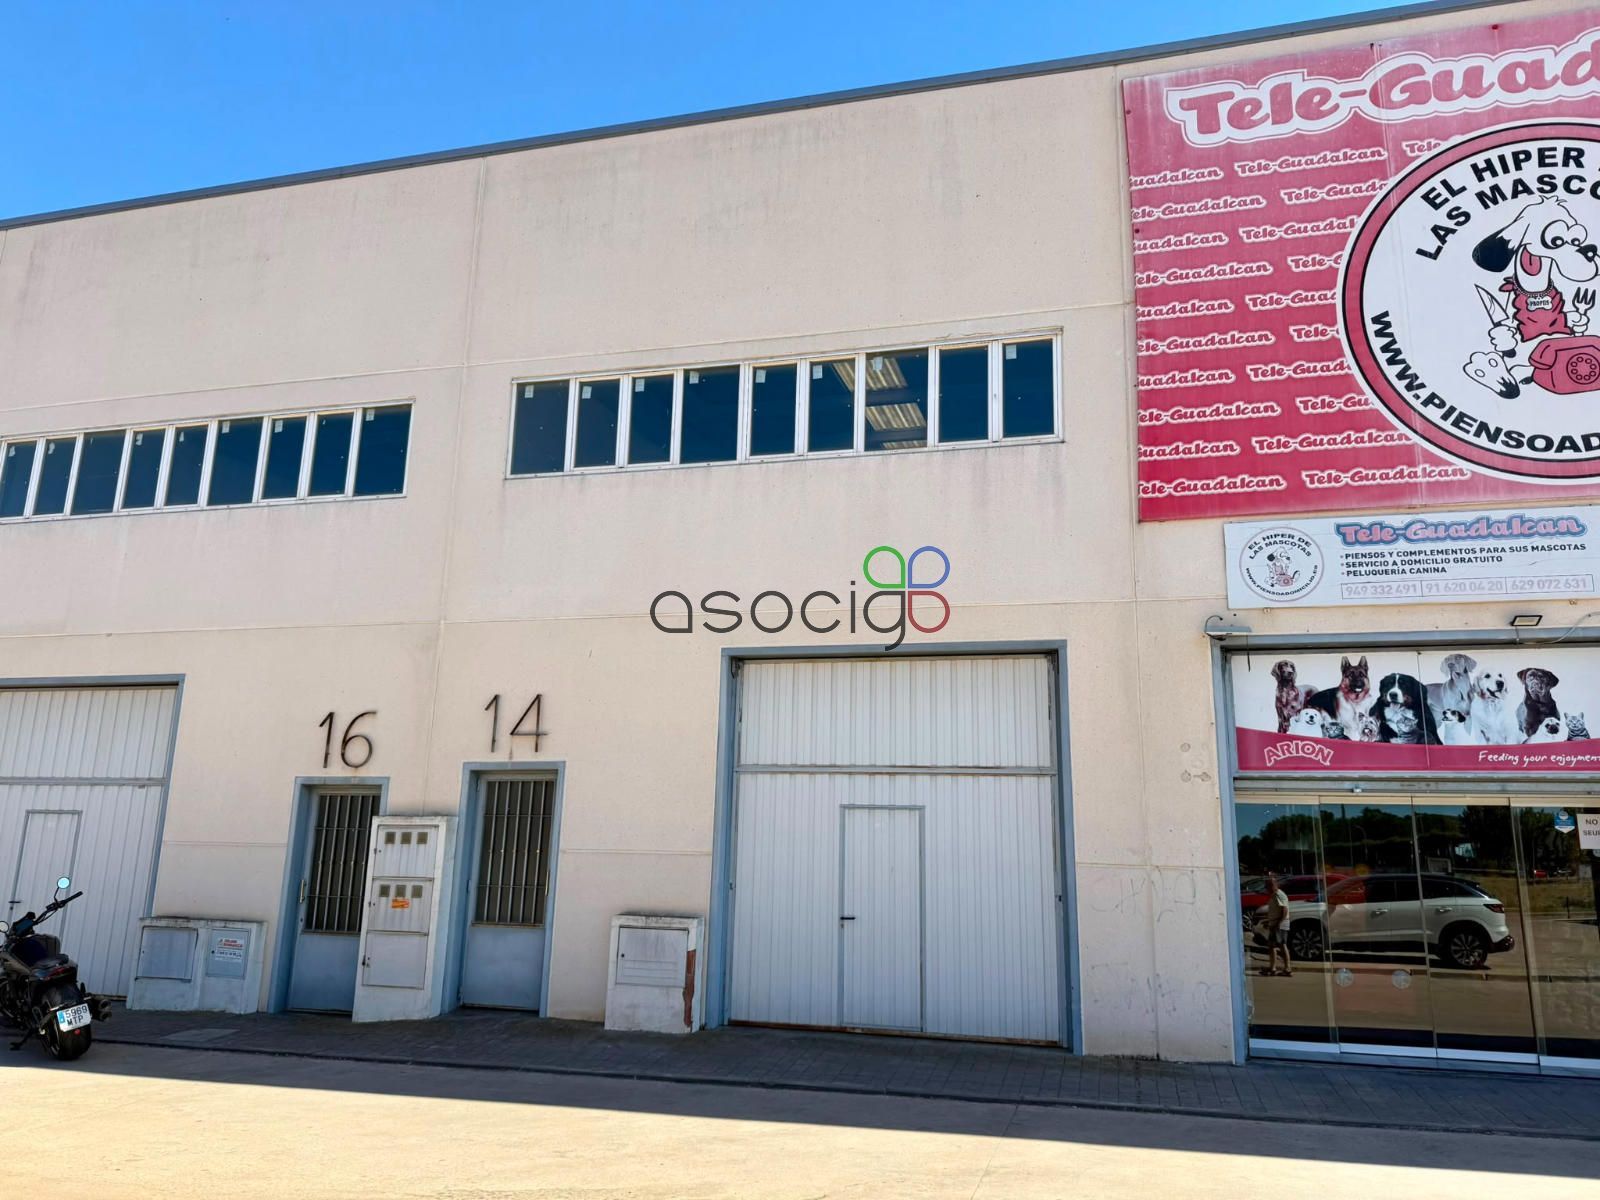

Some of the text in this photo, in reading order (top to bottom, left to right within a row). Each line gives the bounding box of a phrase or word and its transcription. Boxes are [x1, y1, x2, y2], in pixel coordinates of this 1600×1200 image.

[1237, 148, 1386, 175] Tele-Guadalcan
[1420, 146, 1585, 211] EL HIPER
[1131, 196, 1264, 220] ele-Guadalcan
[1133, 232, 1227, 252] uadalcan
[1415, 206, 1471, 261] LAS
[1135, 262, 1271, 286] ele-Guadalcan
[1293, 326, 1340, 339] Tele-
[1250, 360, 1352, 379] Tele-Guad
[1299, 395, 1374, 412] Tele-Gu
[1305, 466, 1467, 486] Tele-Guadalcan
[1338, 516, 1584, 544] Tele-Guadalcan
[1248, 533, 1312, 550] EL HIPER DE
[1249, 540, 1312, 559] LAS MASCOTAS
[1345, 551, 1385, 560] PIENSOS
[1396, 547, 1477, 558] COMPLEMENTOS
[1509, 545, 1529, 553] SUS
[1531, 543, 1587, 552] MASCOTAS
[1345, 560, 1389, 569] SERVICIO
[1401, 558, 1451, 566] DOMICILIO
[1453, 555, 1503, 564] GRATUITO
[1346, 567, 1447, 577] PELUQUERÍA CANINA
[1346, 585, 1368, 596] 949
[1371, 585, 1393, 595] 332
[1425, 581, 1503, 593] 91 620 04 20
[1511, 577, 1587, 591] 629 072 631
[484, 693, 549, 752] 14
[318, 710, 377, 768] 16
[1264, 740, 1334, 767] ARION
[1478, 750, 1520, 765] Feeding
[1523, 755, 1547, 767] your
[67, 1015, 83, 1026] MTP
